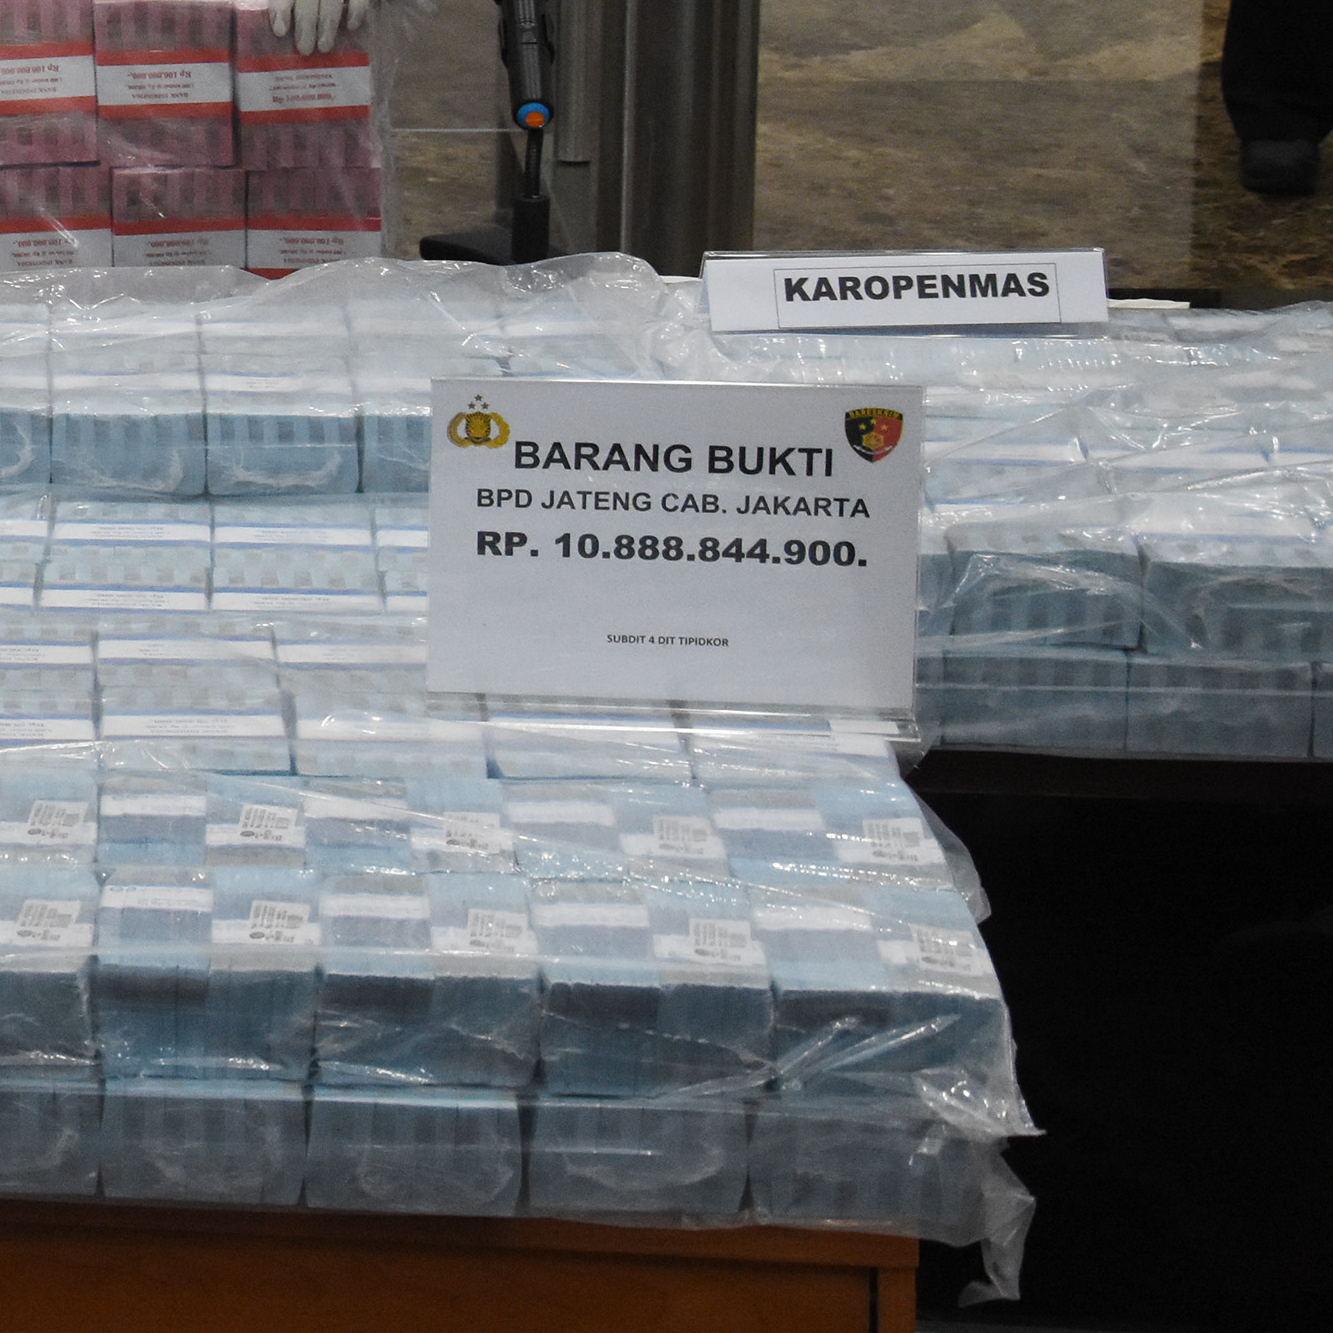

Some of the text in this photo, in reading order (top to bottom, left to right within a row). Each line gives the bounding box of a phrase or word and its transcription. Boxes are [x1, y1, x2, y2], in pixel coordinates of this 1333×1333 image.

[48, 64, 58, 72] Rp
[180, 70, 191, 78] Rp
[785, 273, 1049, 301] KAROPENMAS
[515, 441, 832, 476] BARANG BUKTI
[478, 489, 870, 518] BPD JATENG CAB. JAKARTA
[477, 531, 867, 567] RP. 10.888.844.900.
[607, 634, 729, 647] SUBDIT 4 DIT TIPIDKOR
